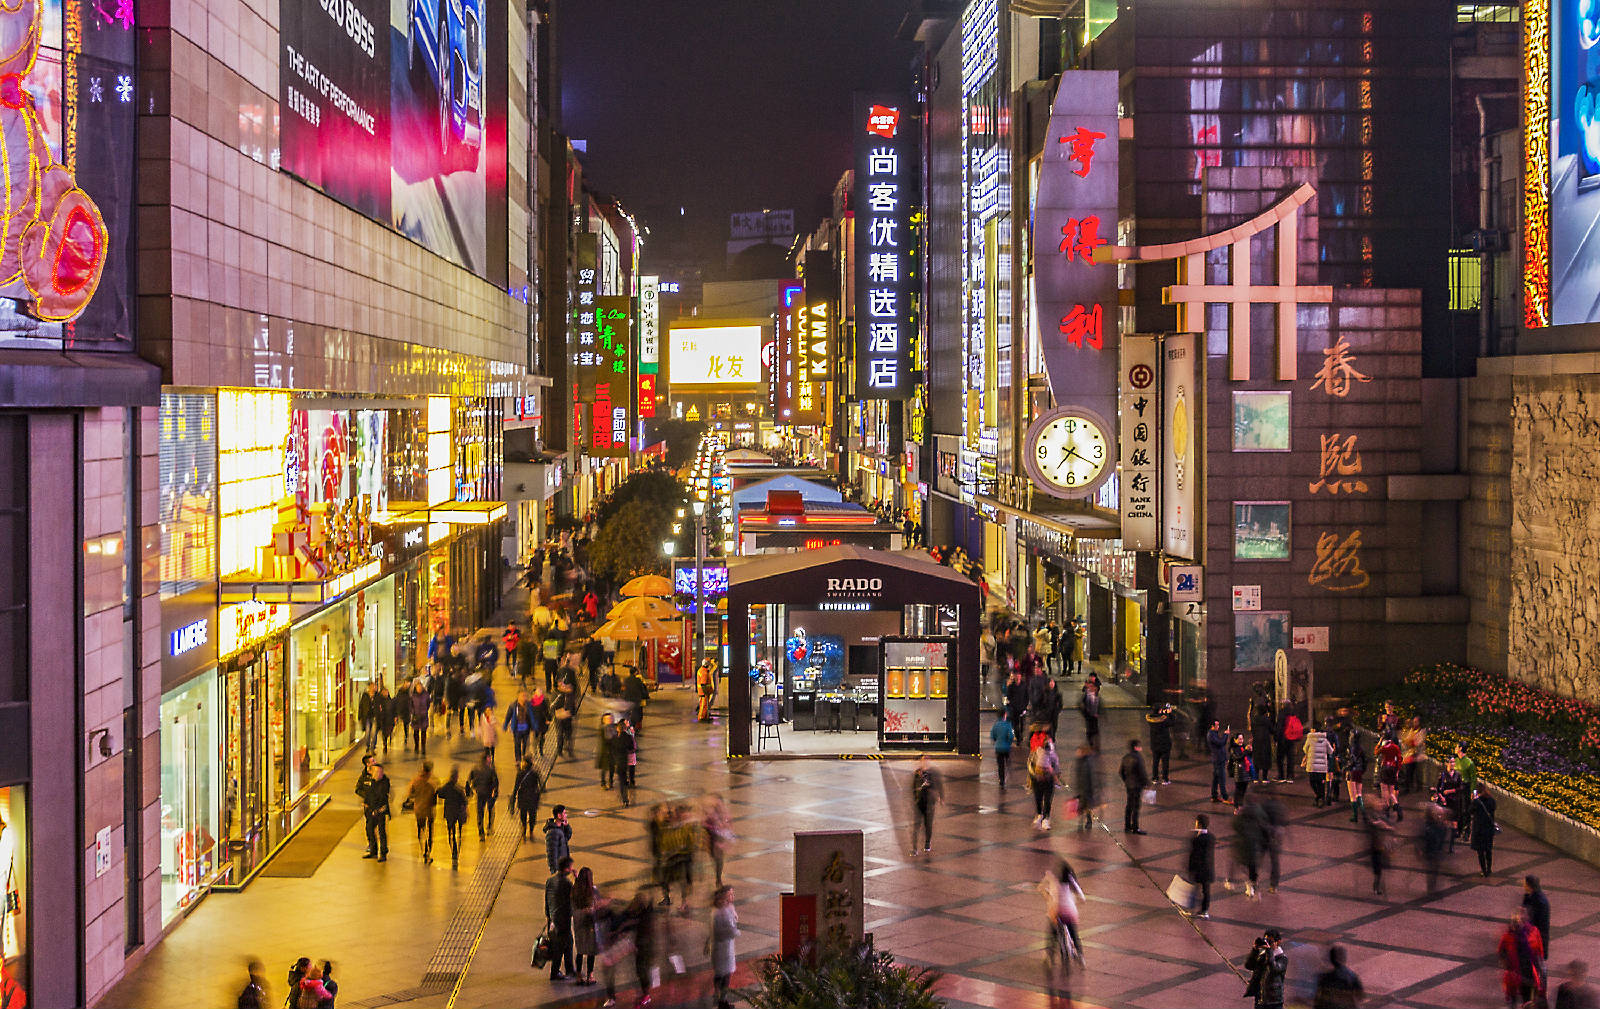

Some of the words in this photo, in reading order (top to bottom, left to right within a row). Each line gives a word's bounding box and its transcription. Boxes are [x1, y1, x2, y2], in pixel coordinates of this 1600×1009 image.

[320, 0, 344, 27] 20
[345, 0, 375, 58] 8955
[287, 45, 304, 78] THE
[305, 61, 319, 90] ART
[320, 74, 330, 97] OF
[330, 82, 375, 135] PERFORMANCE
[1059, 127, 1107, 350] 亨得利
[868, 147, 899, 389] 尚客优精选酒店
[811, 302, 828, 374] KAMA
[1038, 445, 1047, 459] 9
[1093, 445, 1103, 458] 3
[1130, 396, 1151, 493] 中国银行
[1066, 471, 1075, 485] 6
[827, 578, 883, 591] RADO
[1176, 573, 1194, 590] 24
